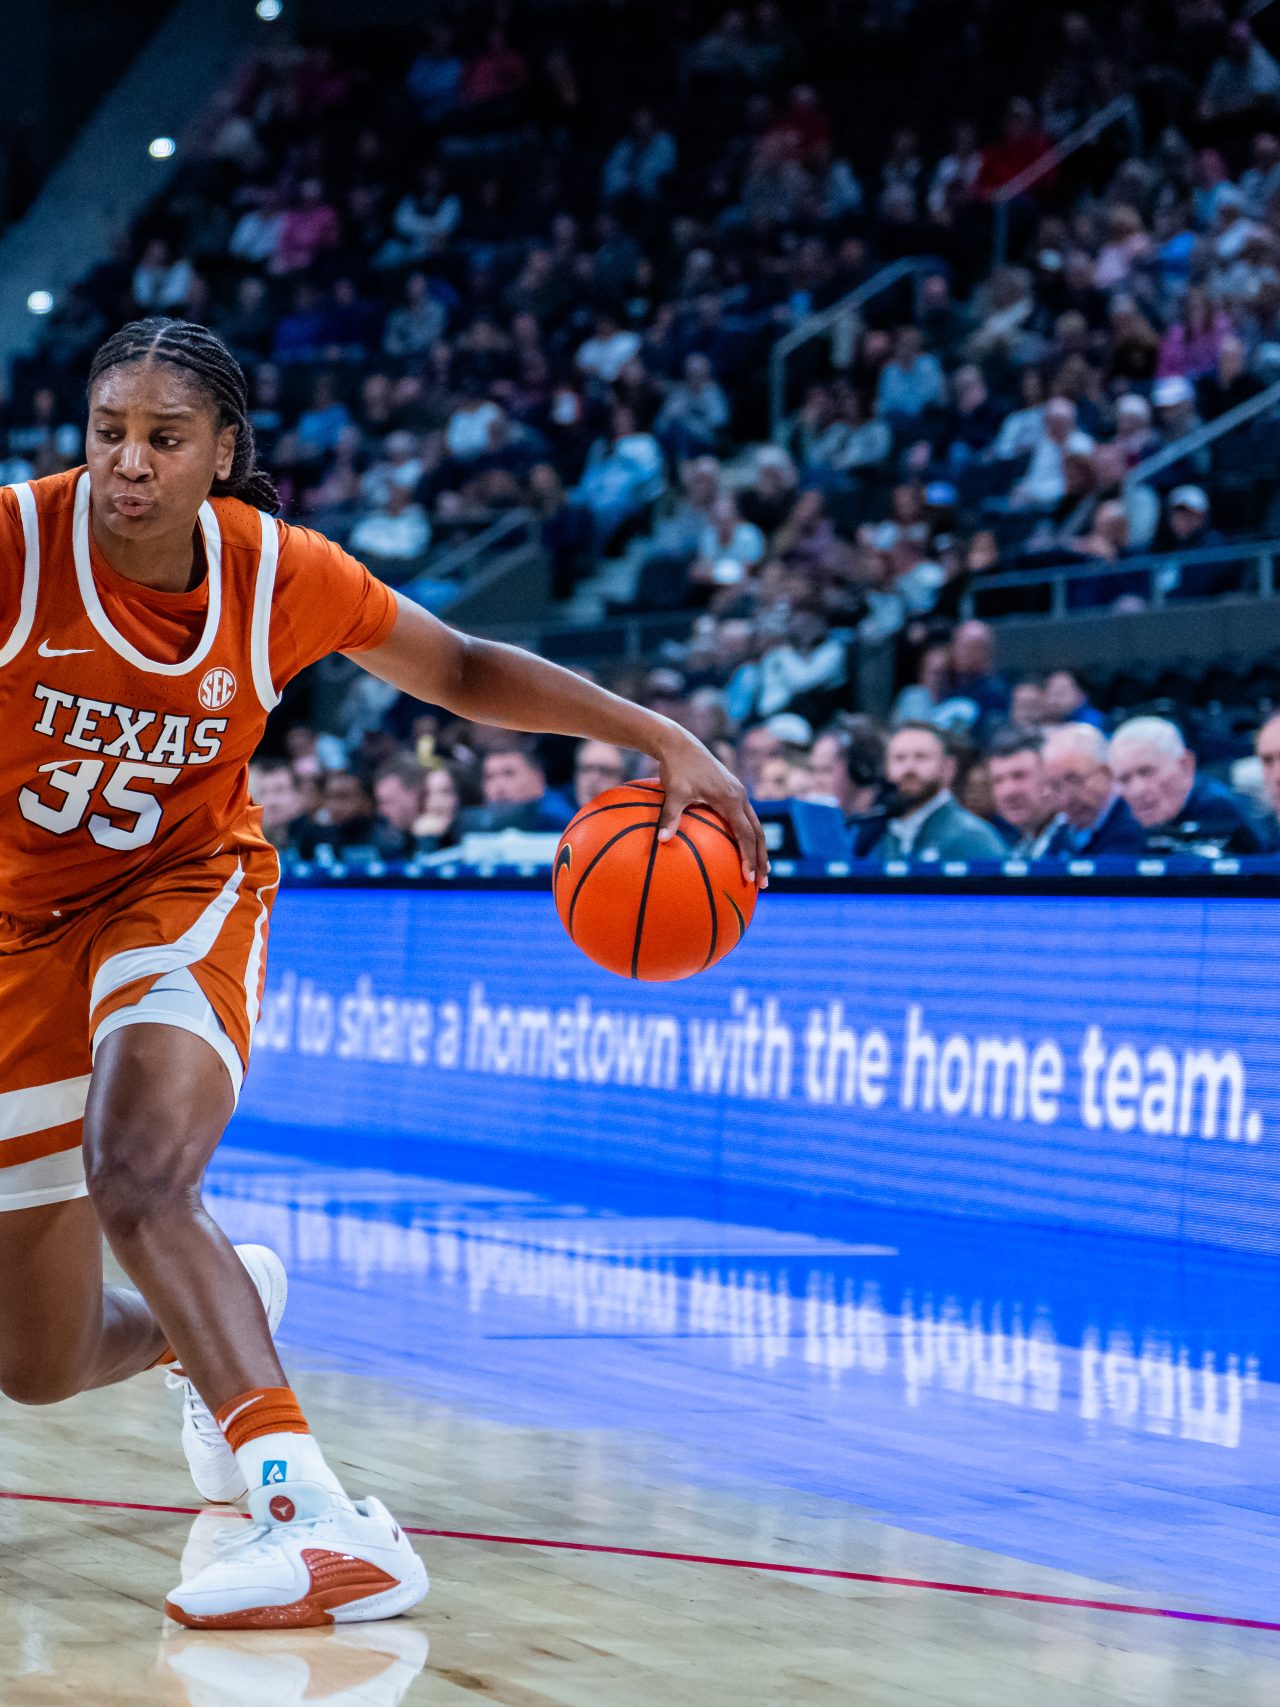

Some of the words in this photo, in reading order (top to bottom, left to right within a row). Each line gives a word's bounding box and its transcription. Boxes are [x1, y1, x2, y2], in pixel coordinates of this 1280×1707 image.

[32, 681, 229, 765] TEXAS
[200, 669, 234, 708] SEC
[18, 759, 182, 851] 35
[298, 976, 335, 1056] to
[336, 973, 433, 1066] share
[437, 1001, 462, 1068] a
[466, 980, 680, 1090] hometown
[687, 987, 792, 1101] with
[805, 999, 890, 1107] the
[902, 1003, 1064, 1123] home
[1080, 1023, 1263, 1144] team.
